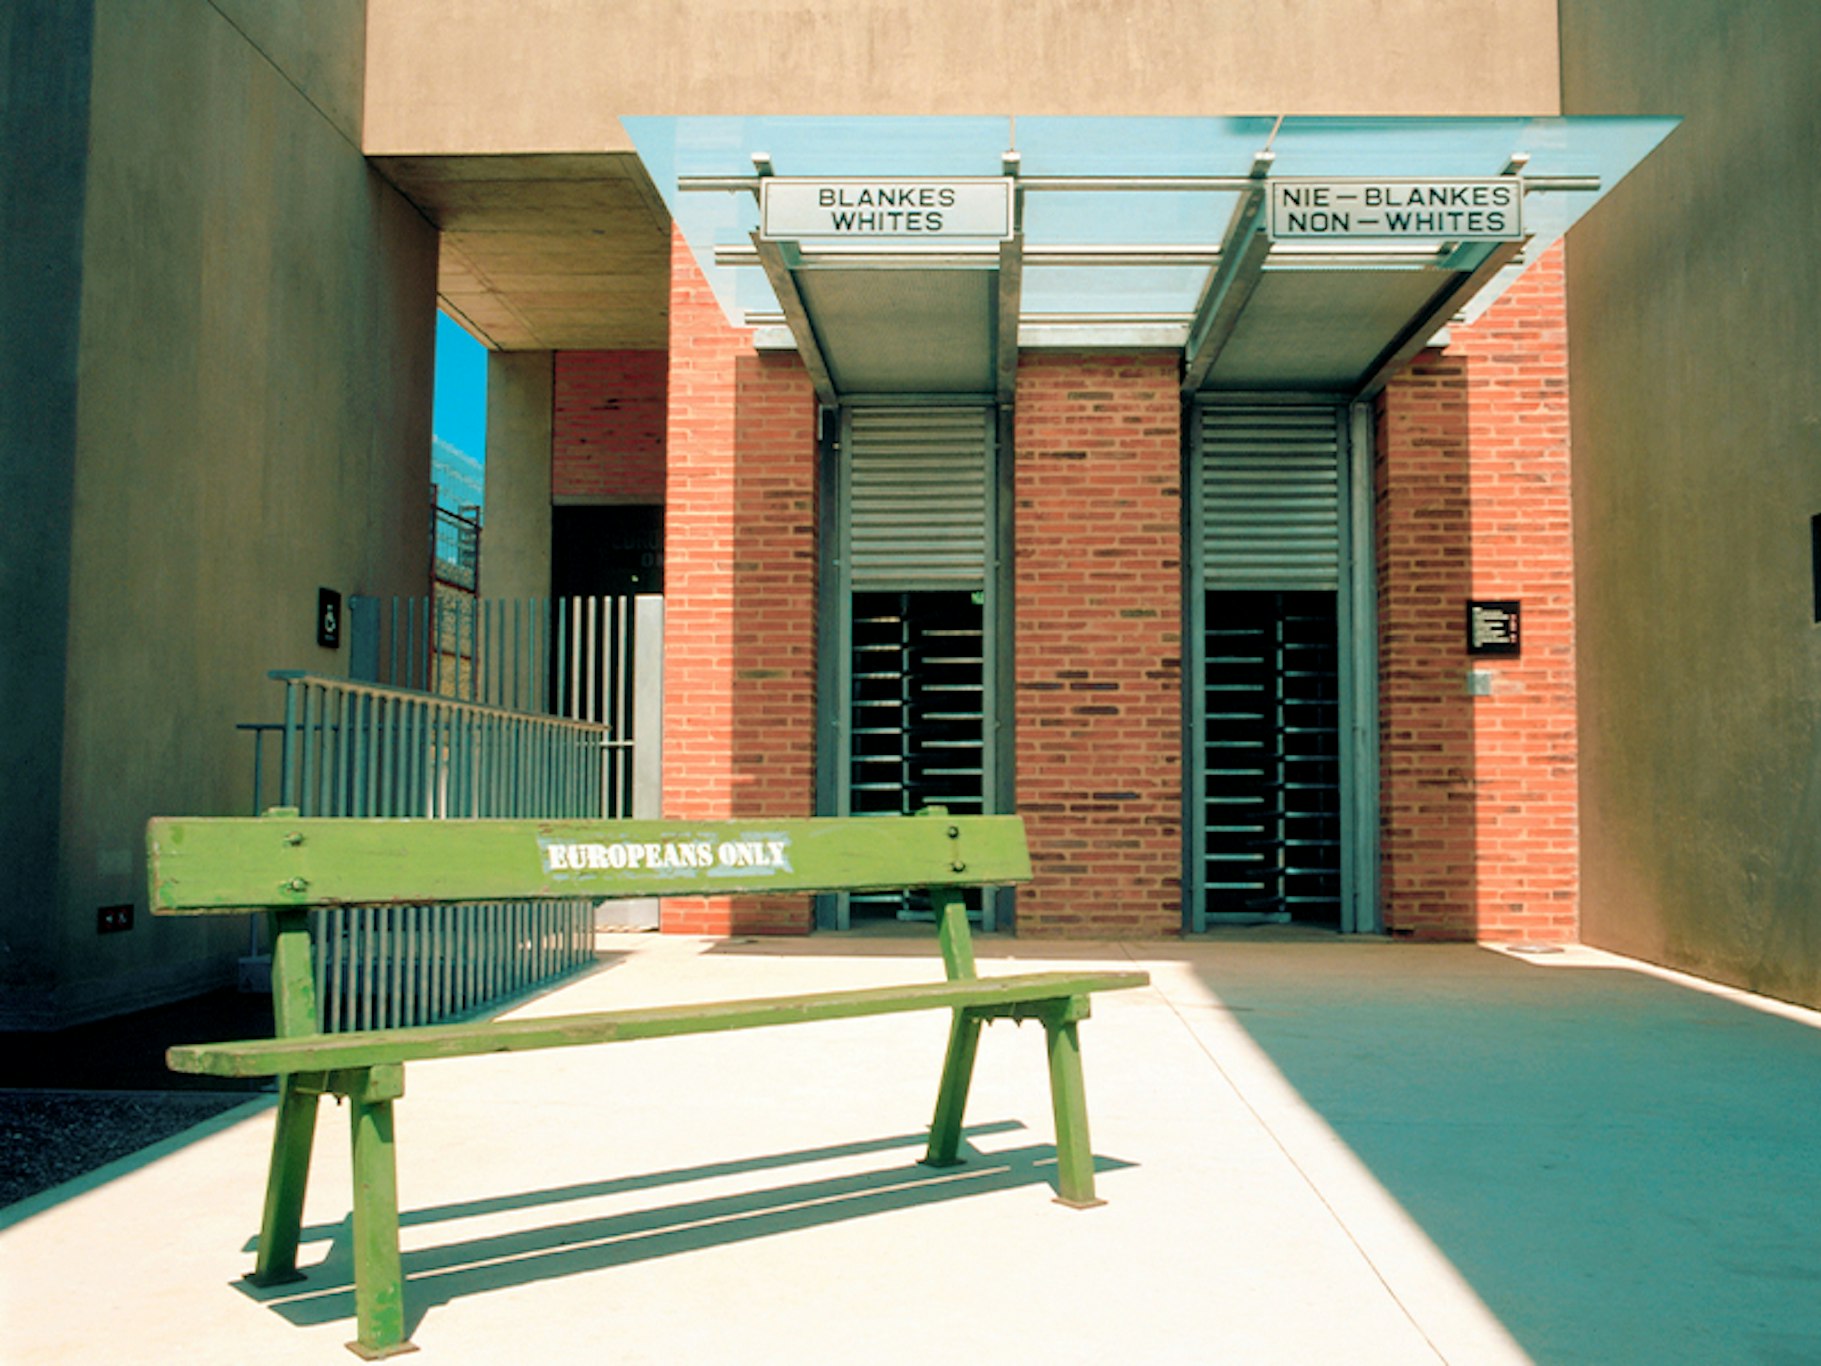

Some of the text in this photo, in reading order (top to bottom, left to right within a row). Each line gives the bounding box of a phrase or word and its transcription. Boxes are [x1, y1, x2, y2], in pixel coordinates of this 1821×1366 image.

[818, 188, 956, 207] BLANKES
[831, 211, 943, 231] WHITES
[547, 841, 785, 870] EUROPEANS ONLY
